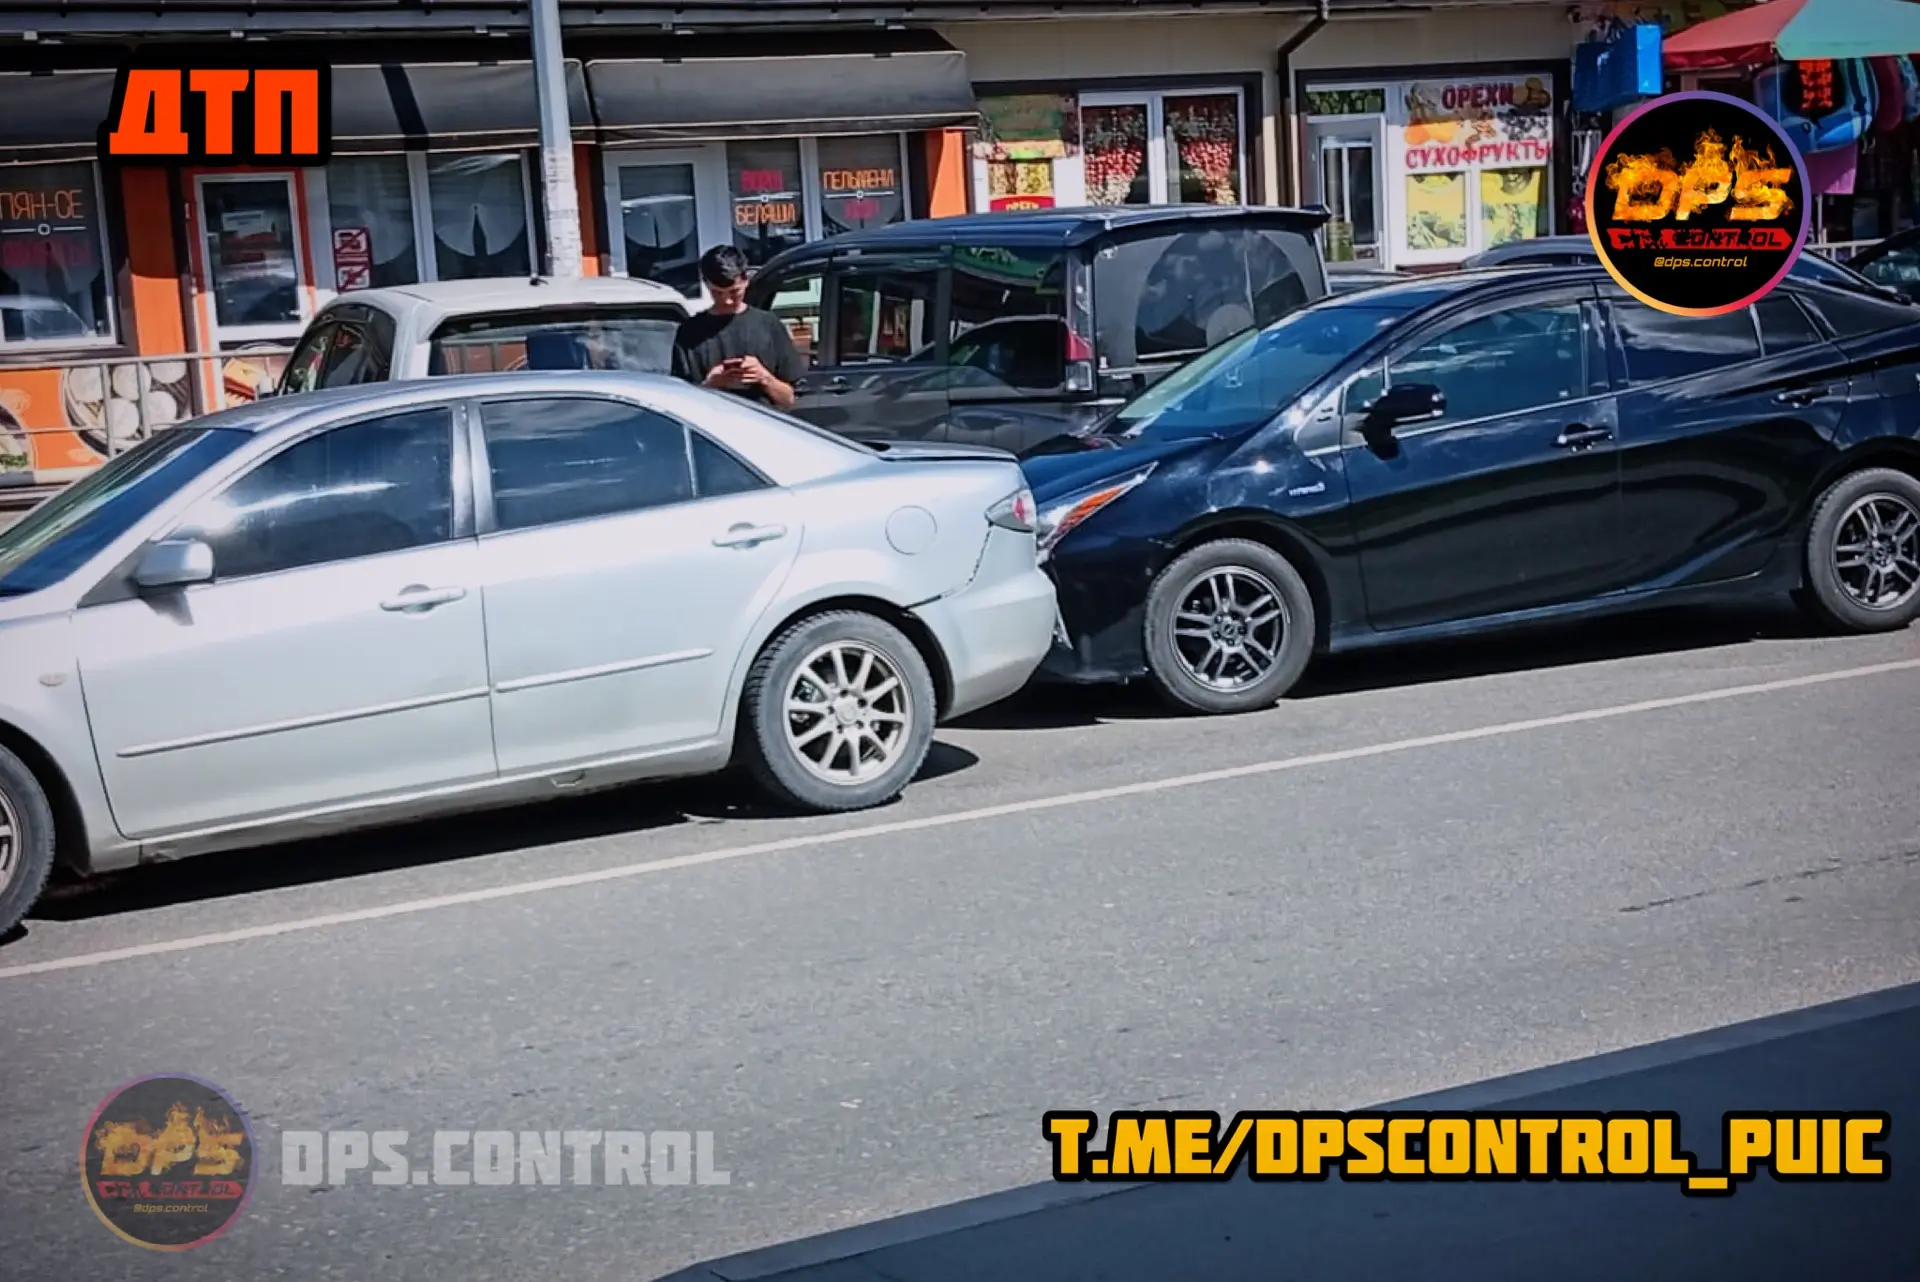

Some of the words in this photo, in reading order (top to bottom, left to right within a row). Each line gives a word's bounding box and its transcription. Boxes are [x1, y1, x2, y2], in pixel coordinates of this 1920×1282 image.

[1442, 83, 1514, 109] ОРЕХИ
[1405, 139, 1552, 169] СУХОФРУКТЫ
[823, 168, 895, 190] ПЕЛЬМЕНИ
[734, 203, 796, 226] БЕЛЯШИ
